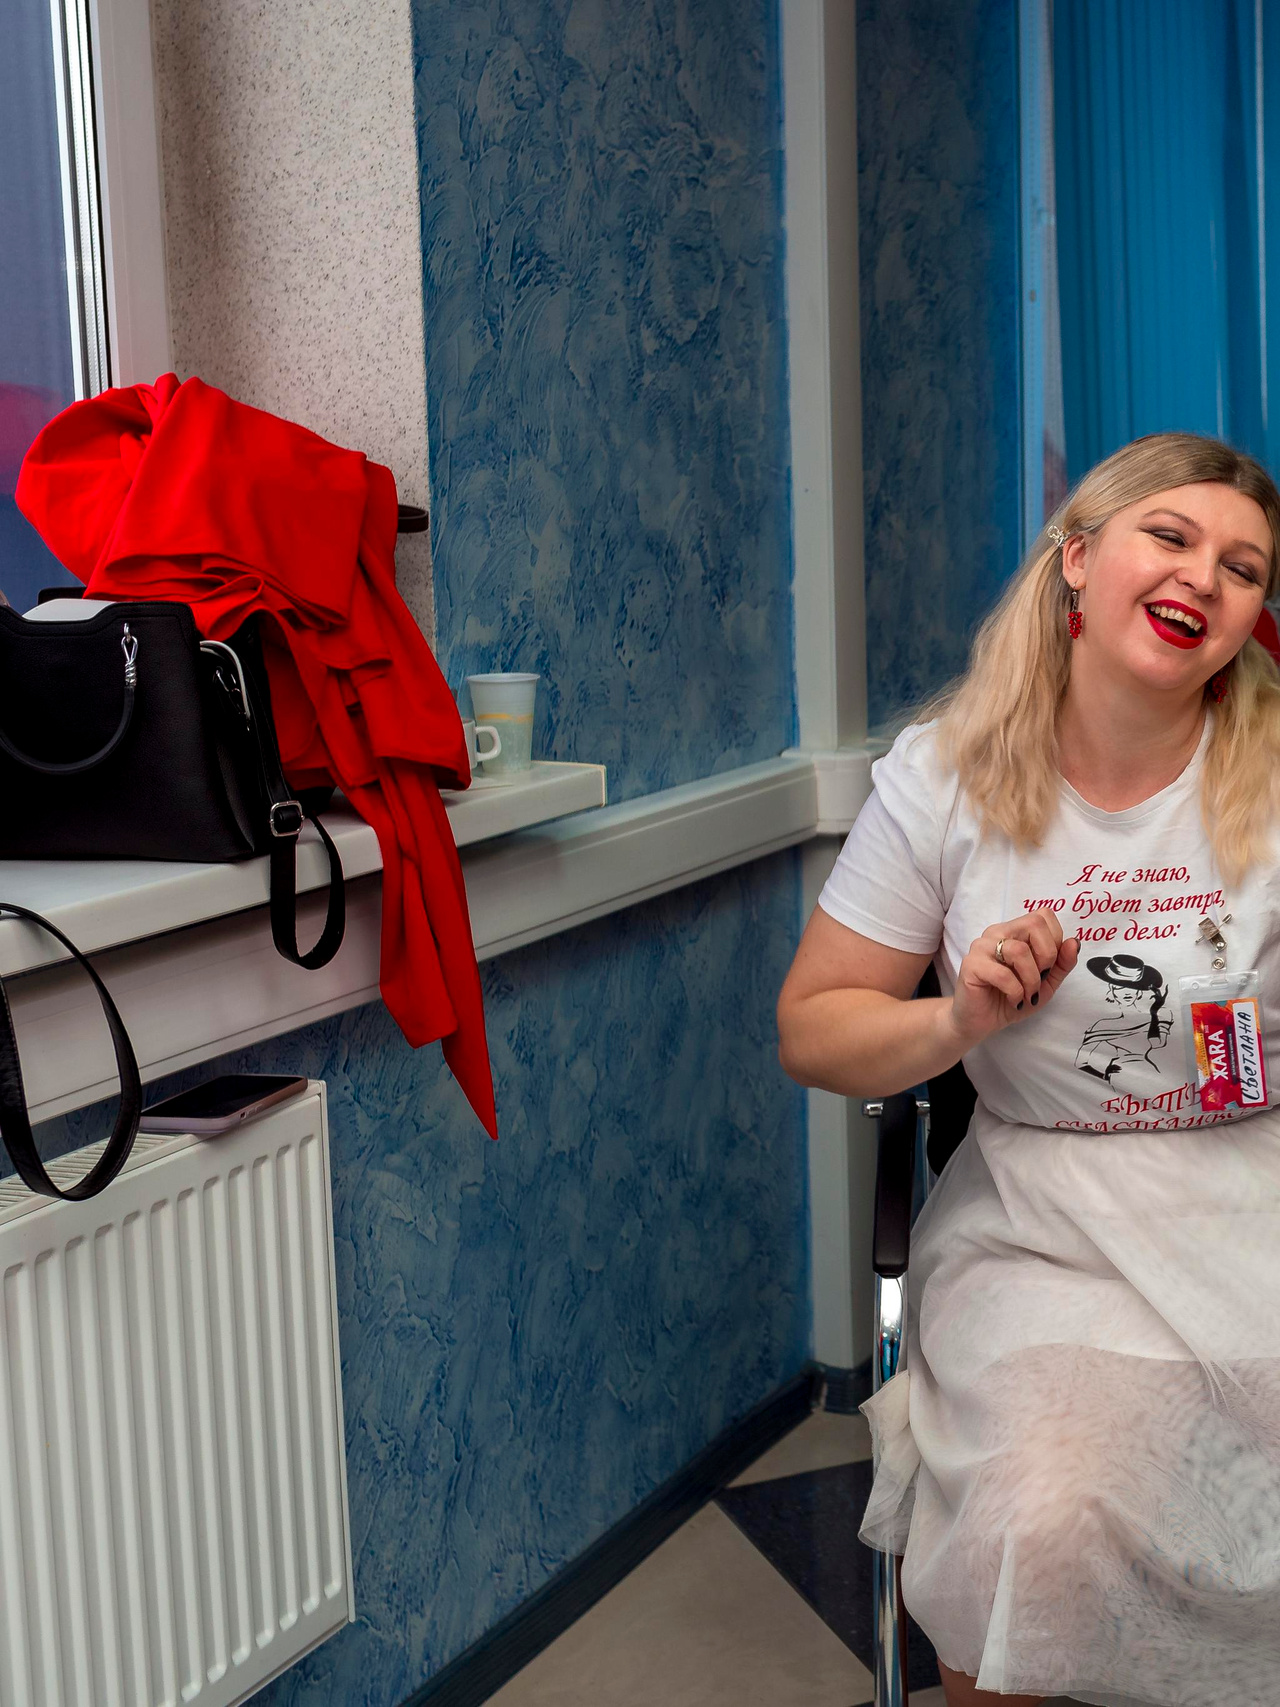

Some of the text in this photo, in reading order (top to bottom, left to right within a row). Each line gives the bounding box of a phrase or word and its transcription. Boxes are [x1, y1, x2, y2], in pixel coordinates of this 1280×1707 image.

[1067, 864, 1191, 886] Я не знаю,
[1023, 898, 1066, 913] что
[1072, 890, 1141, 919] будет
[1074, 919, 1181, 942] мое дело:
